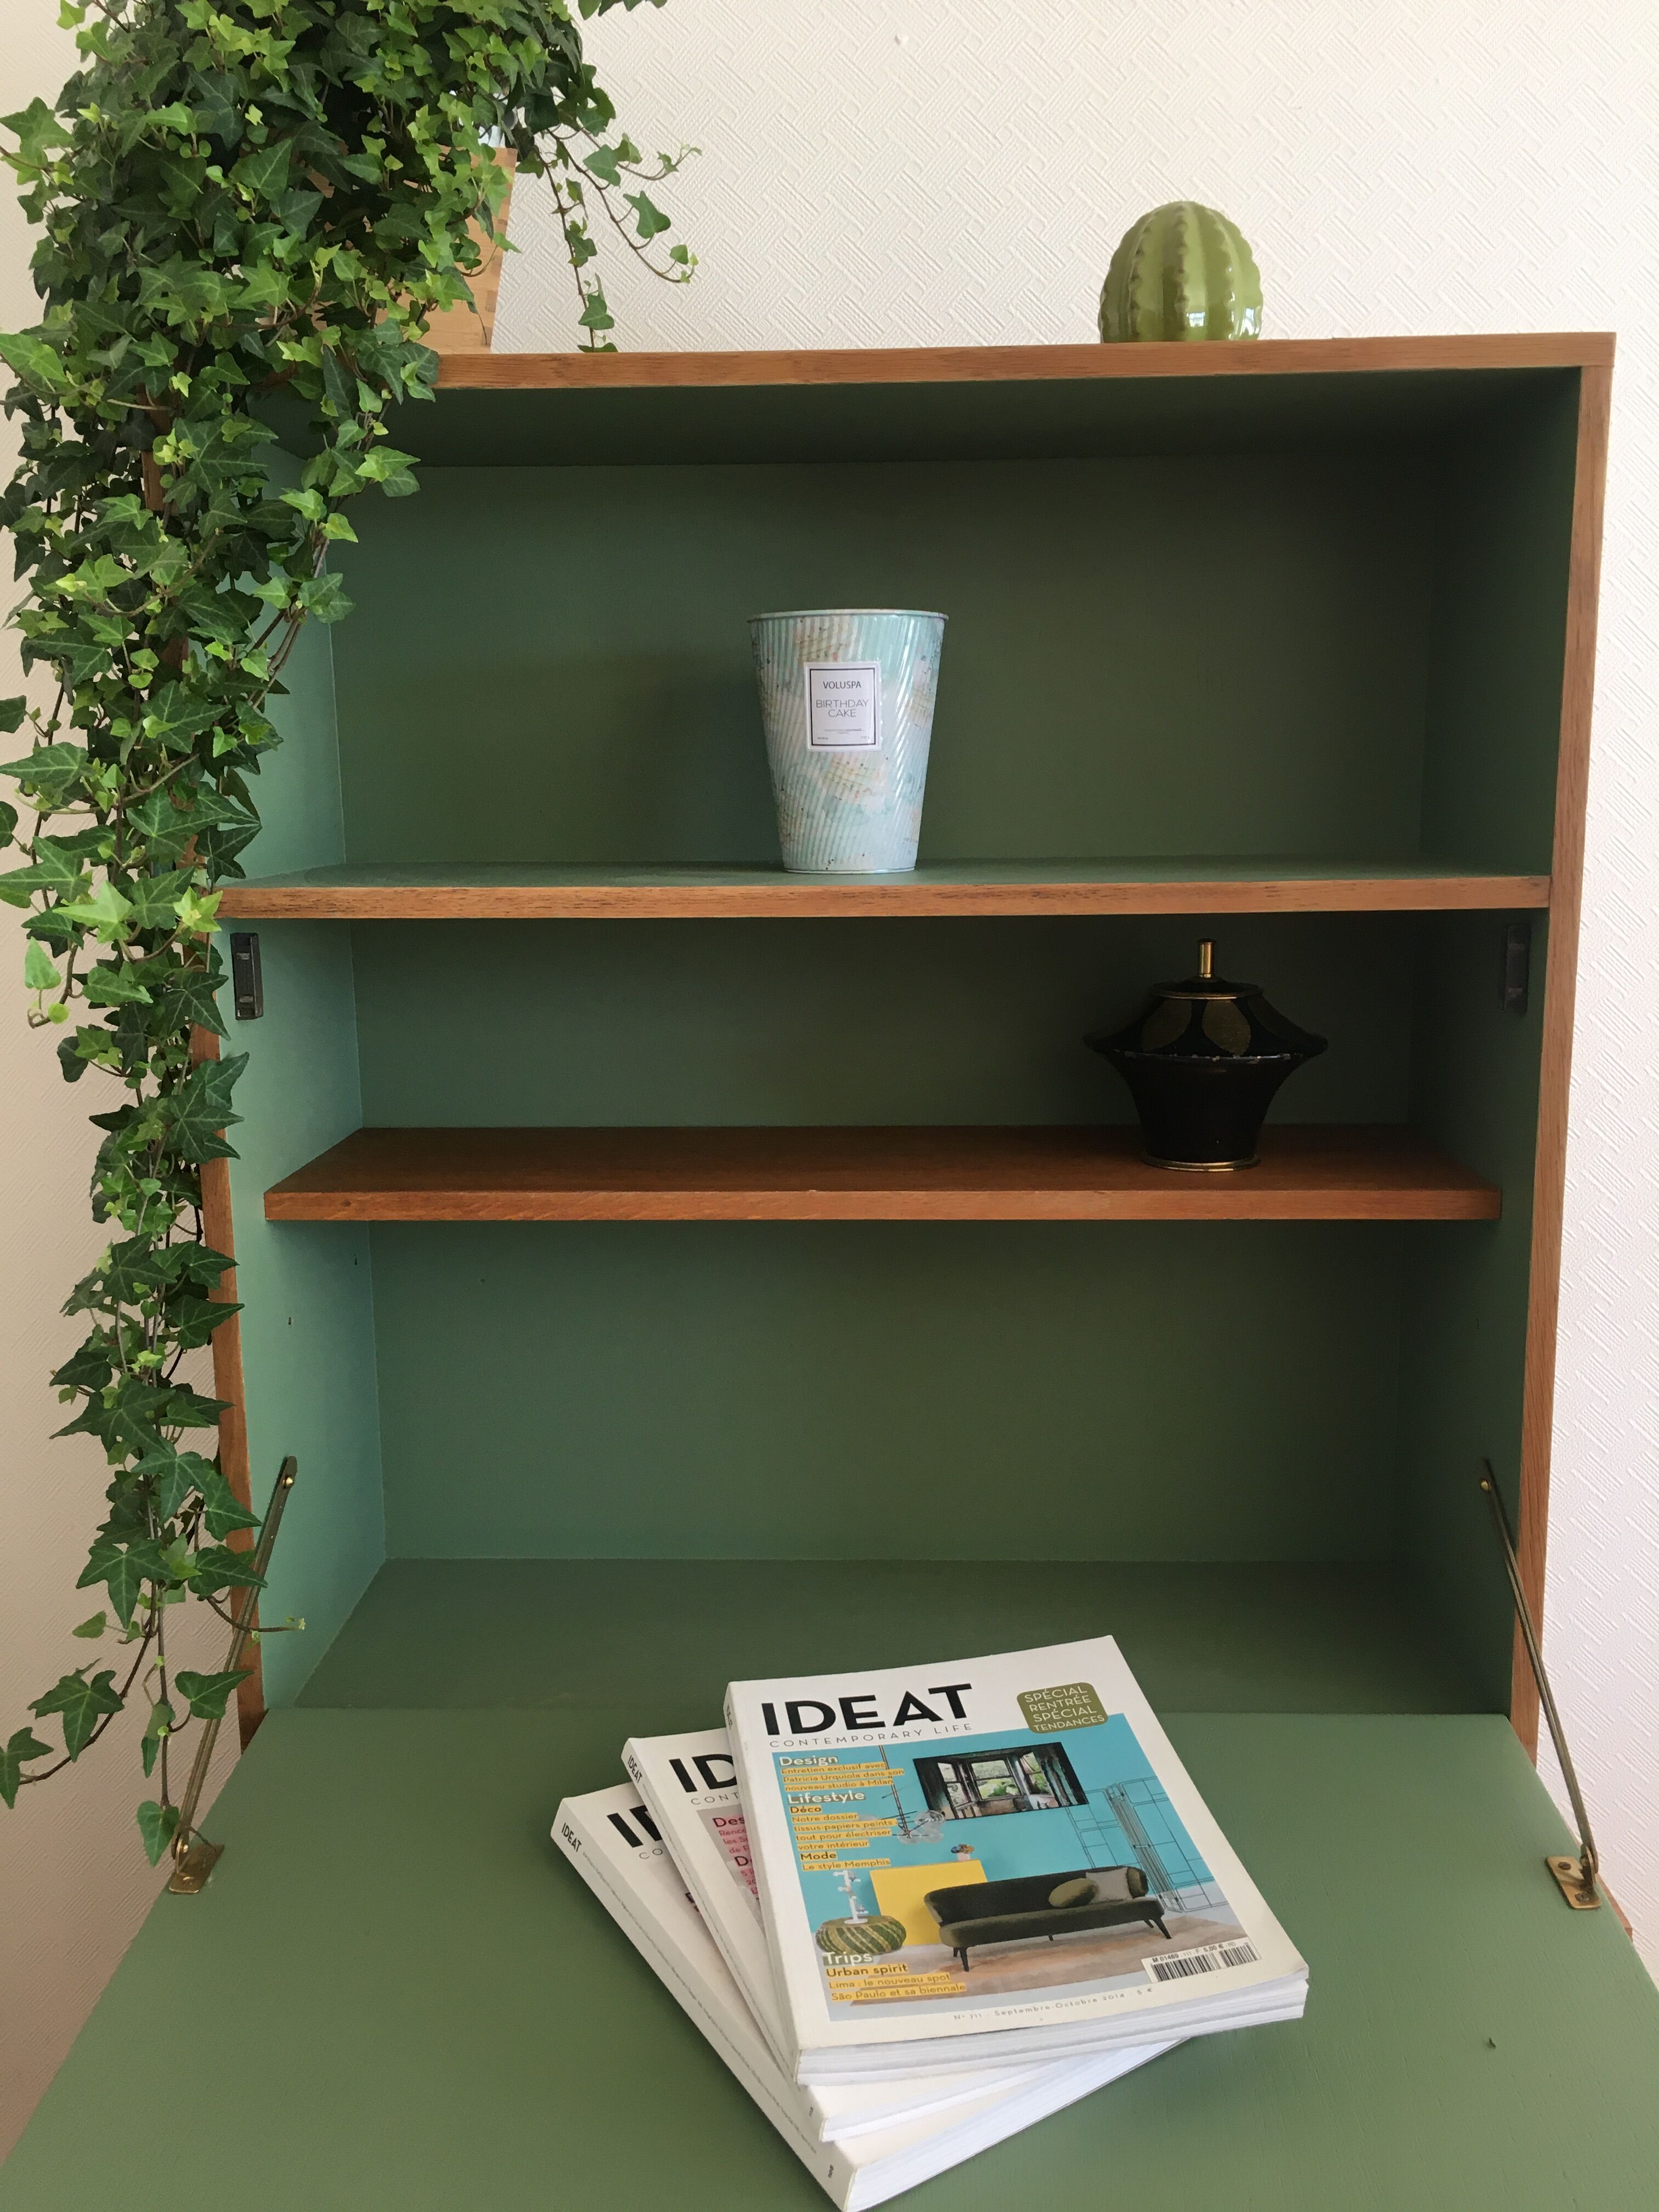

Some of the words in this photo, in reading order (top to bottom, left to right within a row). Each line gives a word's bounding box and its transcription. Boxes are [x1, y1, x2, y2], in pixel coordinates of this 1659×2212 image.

[823, 681, 861, 689] VOLUSPA
[816, 699, 869, 708] BIRTHDAY
[828, 709, 857, 717] CAKE
[1024, 1685, 1087, 1703] SPÉCIAL
[1029, 1694, 1092, 1712] RENTRÉE
[761, 1683, 972, 1736] IDEAT
[1033, 1705, 1097, 1722] SPÉCIAL
[1033, 1714, 1105, 1731] TENDANCES
[770, 1729, 923, 1748] CONTEMPORARY
[934, 1723, 973, 1735] LIFE
[778, 1755, 838, 1766] Design
[627, 1755, 643, 1784] IDEAT
[781, 1765, 825, 1774] Entretien
[783, 1774, 819, 1782] Patricia
[821, 1773, 860, 1781] Urquiola
[868, 1778, 894, 1786] Milan
[787, 1790, 865, 1804] Lifestyle
[790, 1805, 822, 1814] Déco
[823, 1813, 858, 1821] dossier
[794, 1821, 860, 1832] tissus-papiers
[863, 1819, 893, 1829] peints
[561, 1822, 582, 1853] IDEAT
[820, 1833, 842, 1841] pour
[845, 1829, 891, 1838] électriser
[798, 1842, 824, 1850] votre
[826, 1839, 869, 1849] intérieur
[734, 1856, 752, 1866] D
[800, 1851, 837, 1860] Mode
[817, 1861, 842, 1870] style
[844, 1859, 891, 1868] Memphis
[822, 1951, 873, 1966] Trips
[826, 1966, 869, 1977] Urban
[873, 1963, 909, 1976] spirit
[828, 1980, 855, 1989] Lima
[863, 1978, 874, 1987] le
[877, 1976, 924, 1986] nouveau
[927, 1973, 951, 1983] spot
[831, 1991, 852, 2001] São
[855, 1989, 887, 1999] Paulo
[919, 1984, 967, 1995] biennale
